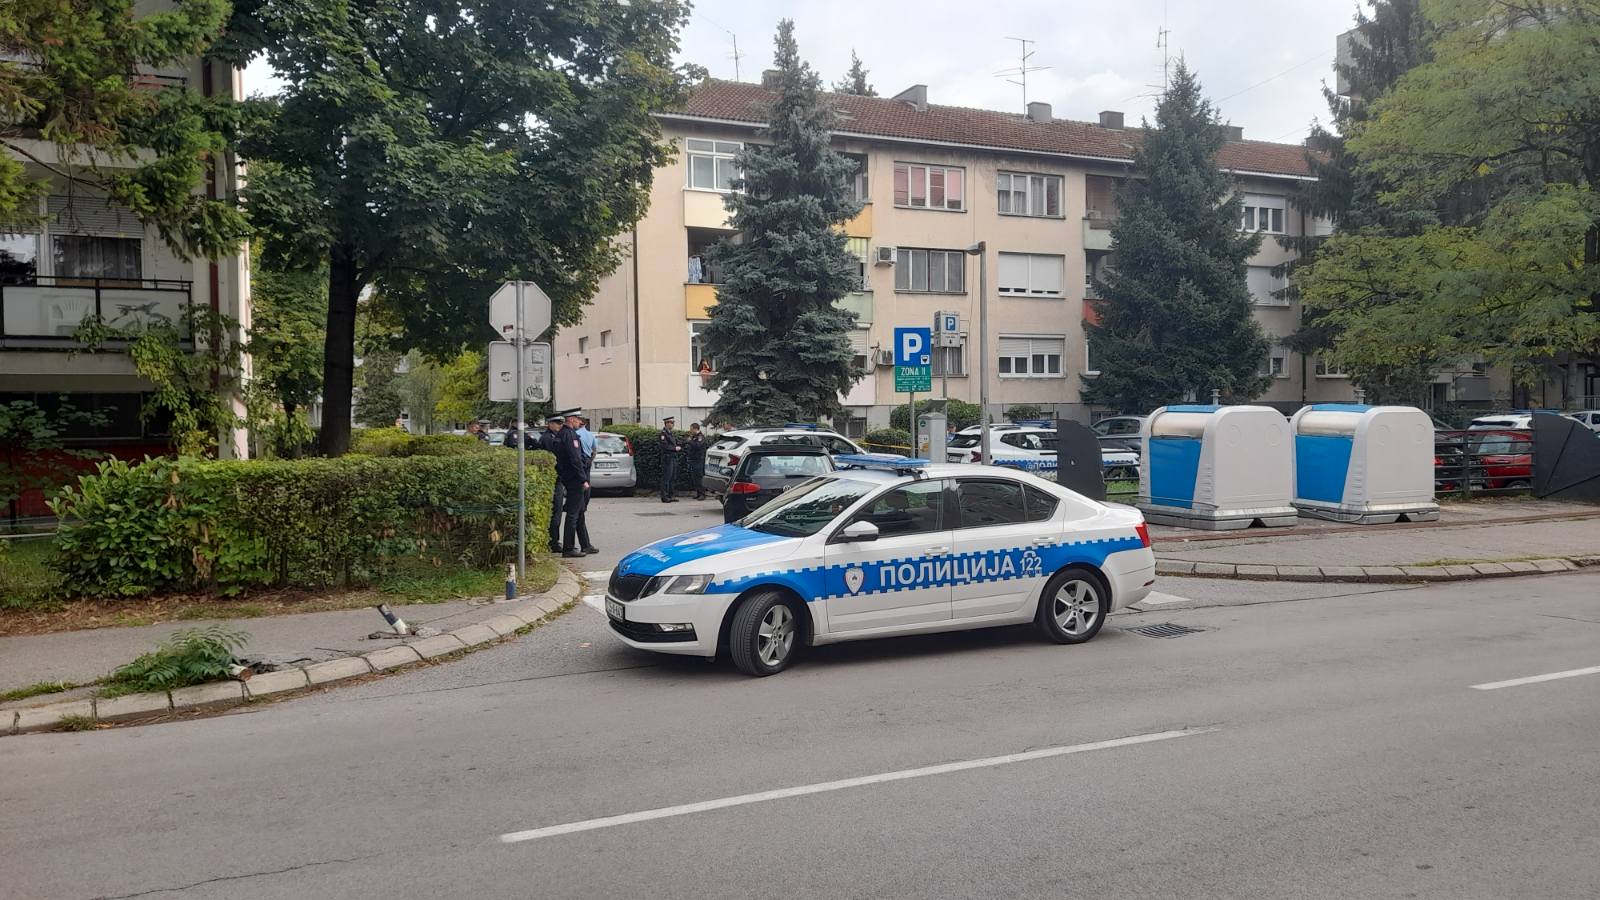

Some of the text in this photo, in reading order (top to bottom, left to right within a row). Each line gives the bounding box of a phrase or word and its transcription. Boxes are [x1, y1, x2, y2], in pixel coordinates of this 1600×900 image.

[948, 318, 954, 330] P
[903, 333, 922, 361] P
[901, 367, 919, 375] ZONA
[879, 554, 1042, 587] ПОЛИЦИЈА 122
